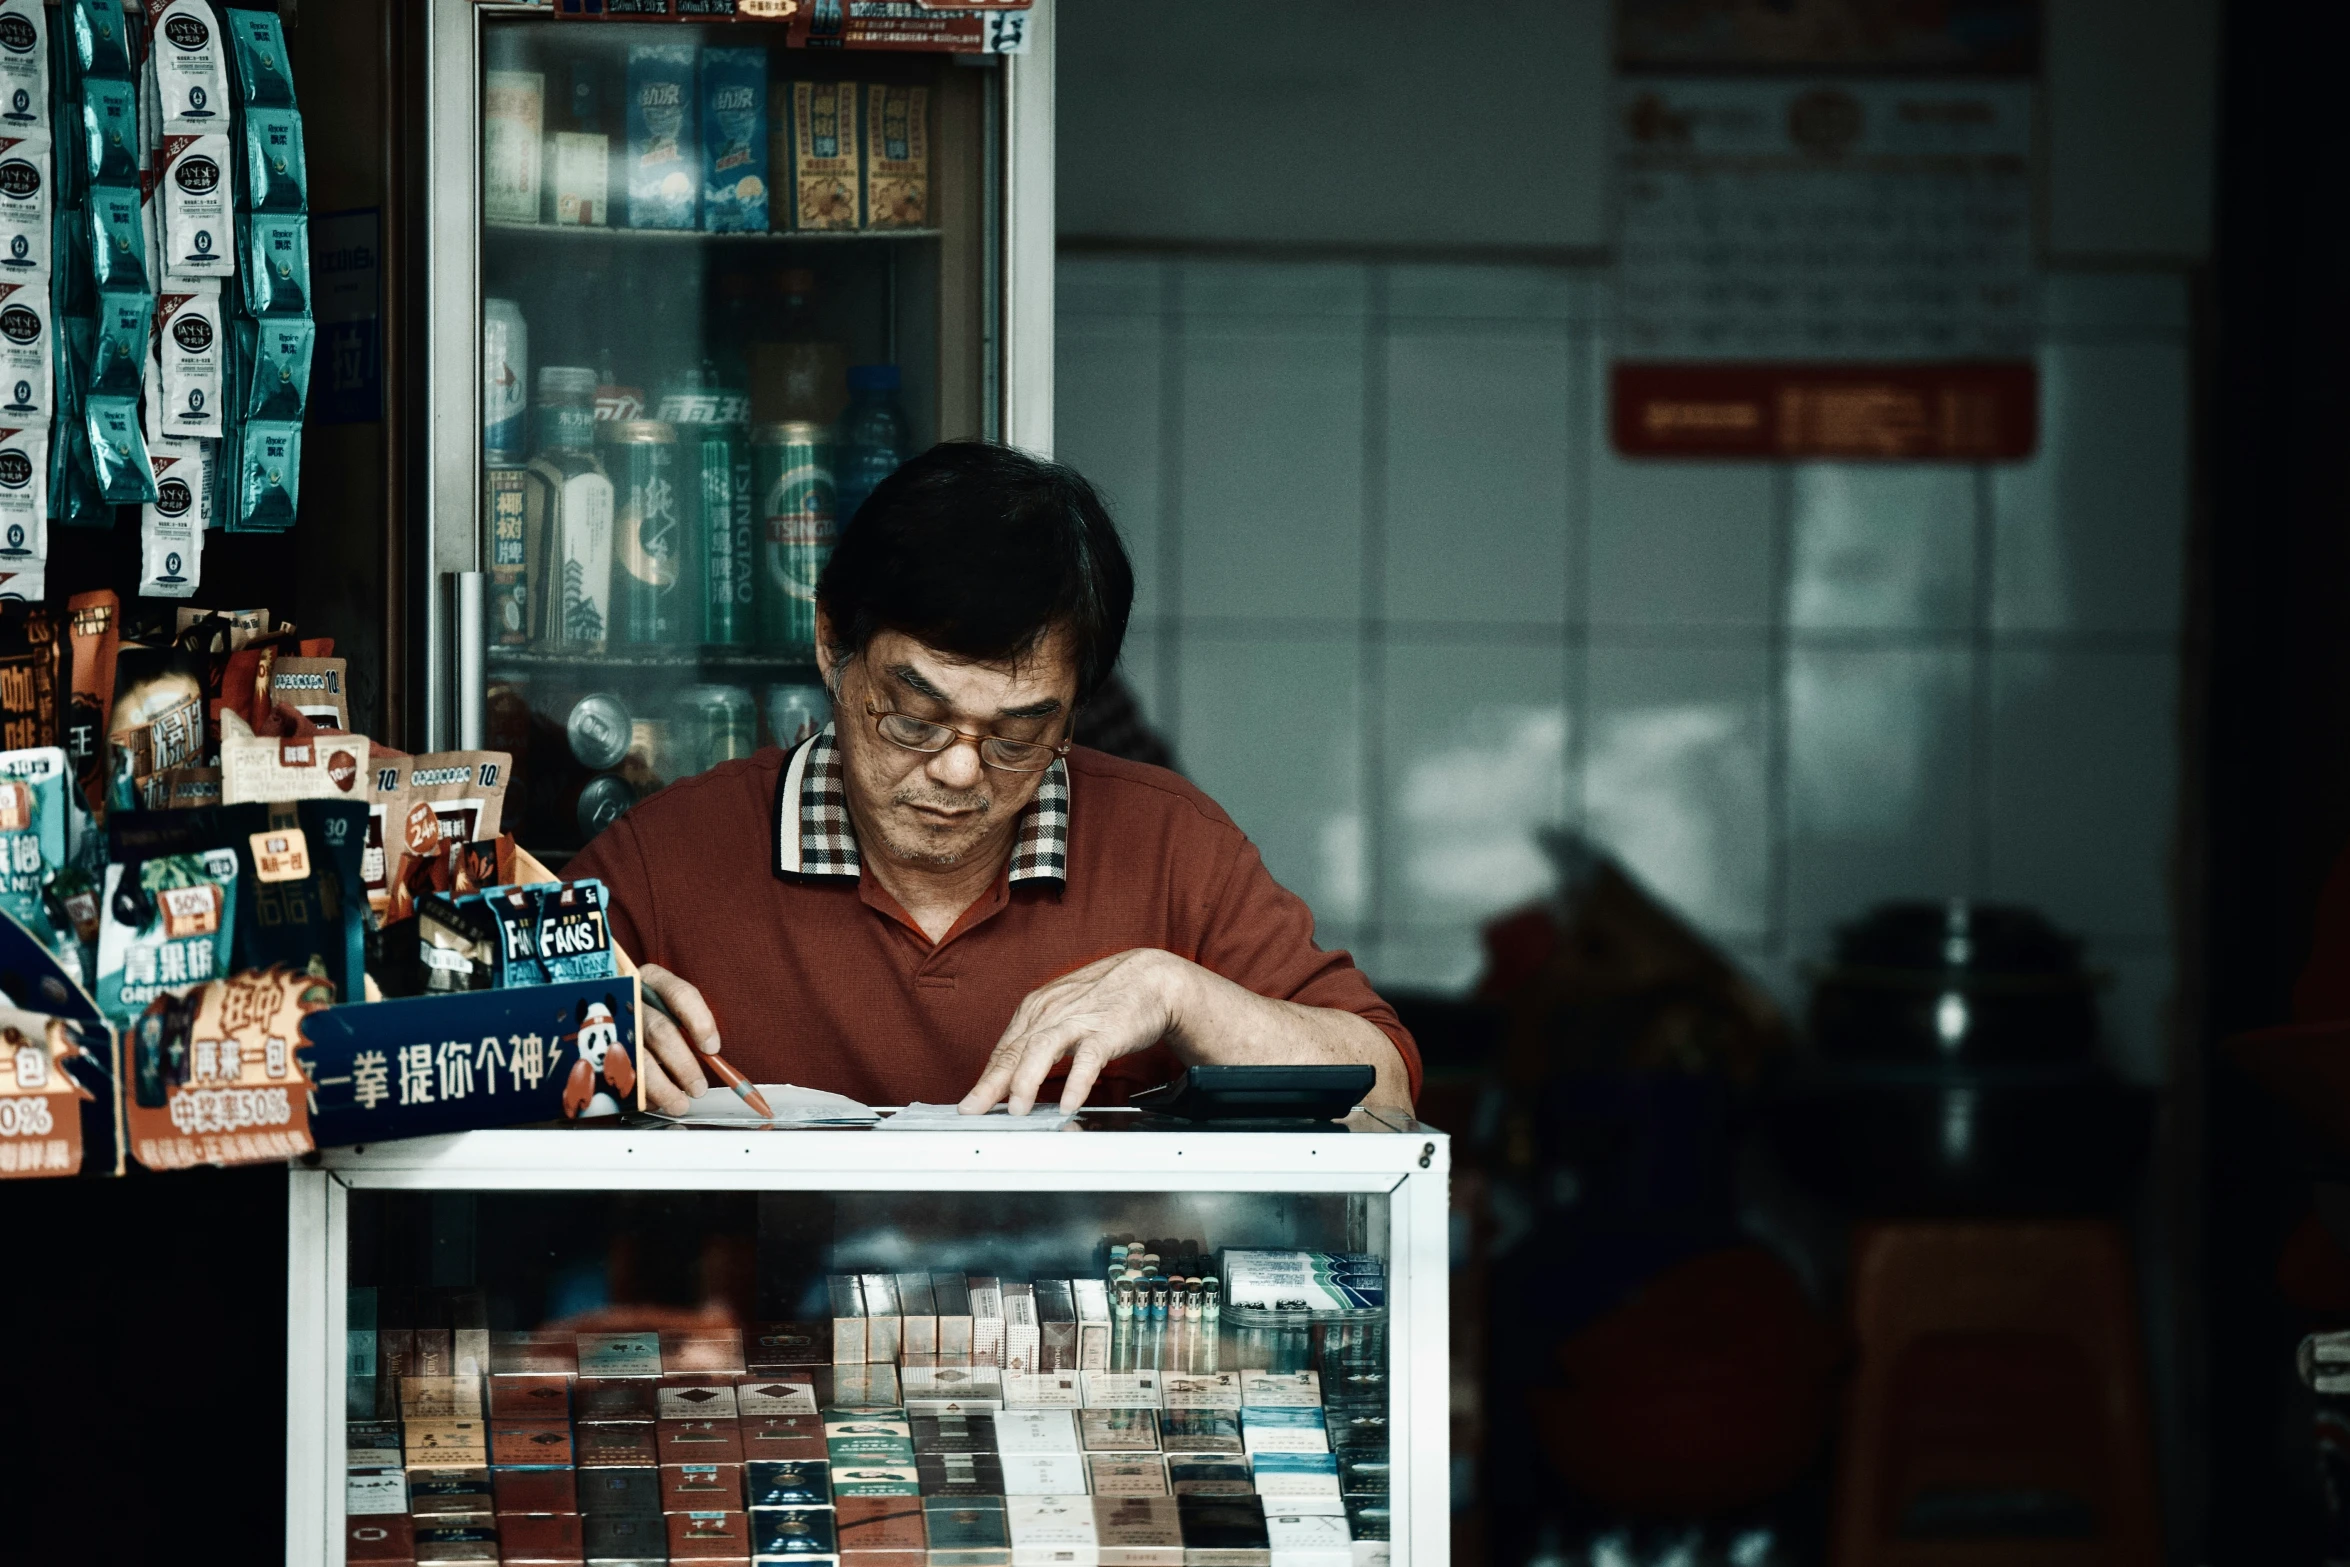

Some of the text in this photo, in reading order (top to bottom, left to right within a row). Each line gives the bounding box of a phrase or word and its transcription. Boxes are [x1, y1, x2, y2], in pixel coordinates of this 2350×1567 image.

[249, 21, 269, 31] Rejoice
[267, 123, 289, 134] Rejoice
[272, 229, 293, 239] Rejoice
[278, 332, 299, 343] Rejoice
[265, 436, 287, 446] Rejoice
[495, 491, 523, 565] 椰树牌
[735, 462, 754, 605] TSINGTAO
[770, 519, 838, 539] TSINGTA
[324, 817, 348, 837] 30
[539, 911, 605, 958] FANS 7
